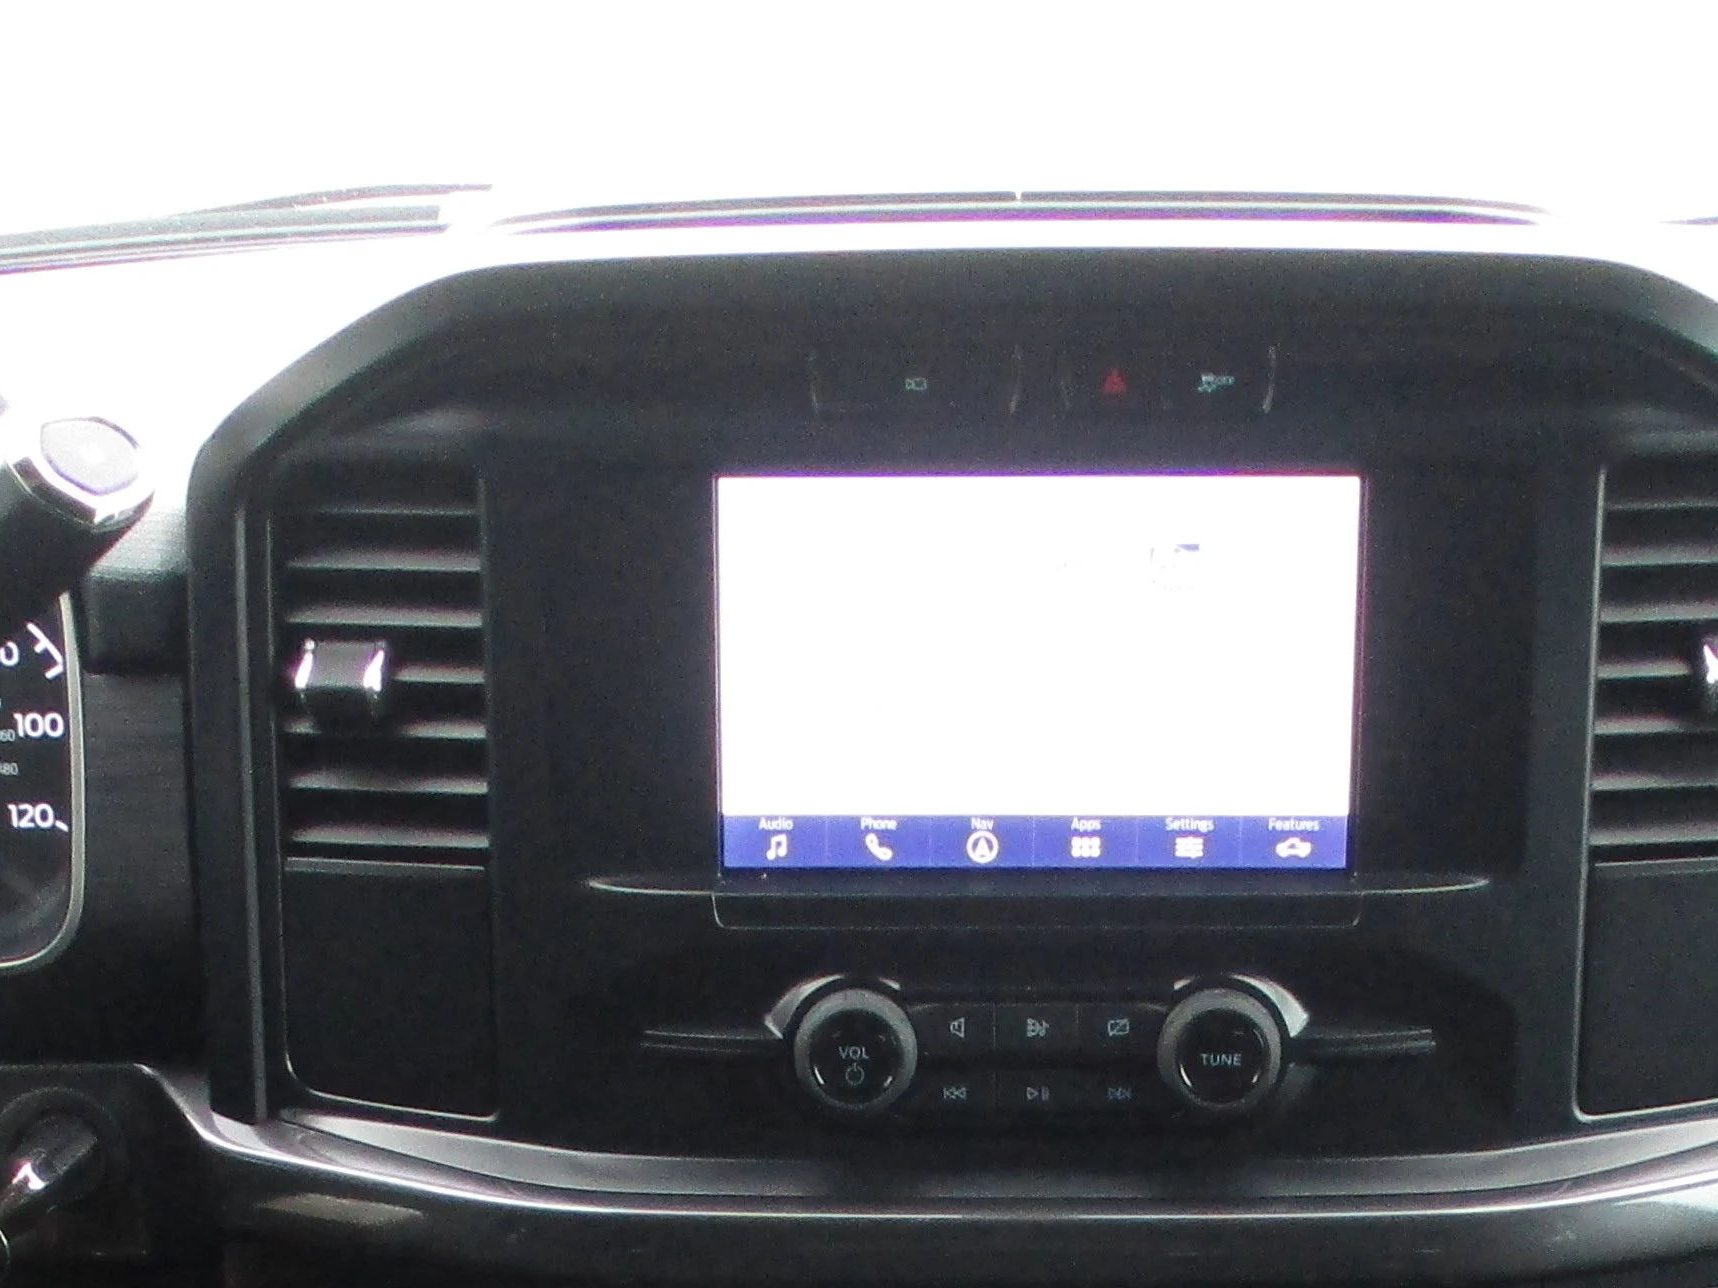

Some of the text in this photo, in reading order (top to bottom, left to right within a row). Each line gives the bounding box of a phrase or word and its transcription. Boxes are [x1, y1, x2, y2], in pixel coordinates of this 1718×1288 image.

[13, 712, 65, 739] 100
[7, 803, 55, 830] 120
[758, 816, 794, 831] Audio
[860, 816, 898, 831] Phone
[970, 817, 995, 831] Nav
[1267, 816, 1321, 832] Features
[1070, 817, 1102, 833] Apps
[1164, 816, 1215, 833] Settings
[838, 1045, 870, 1060] VOL
[1199, 1052, 1243, 1067] TUNE
